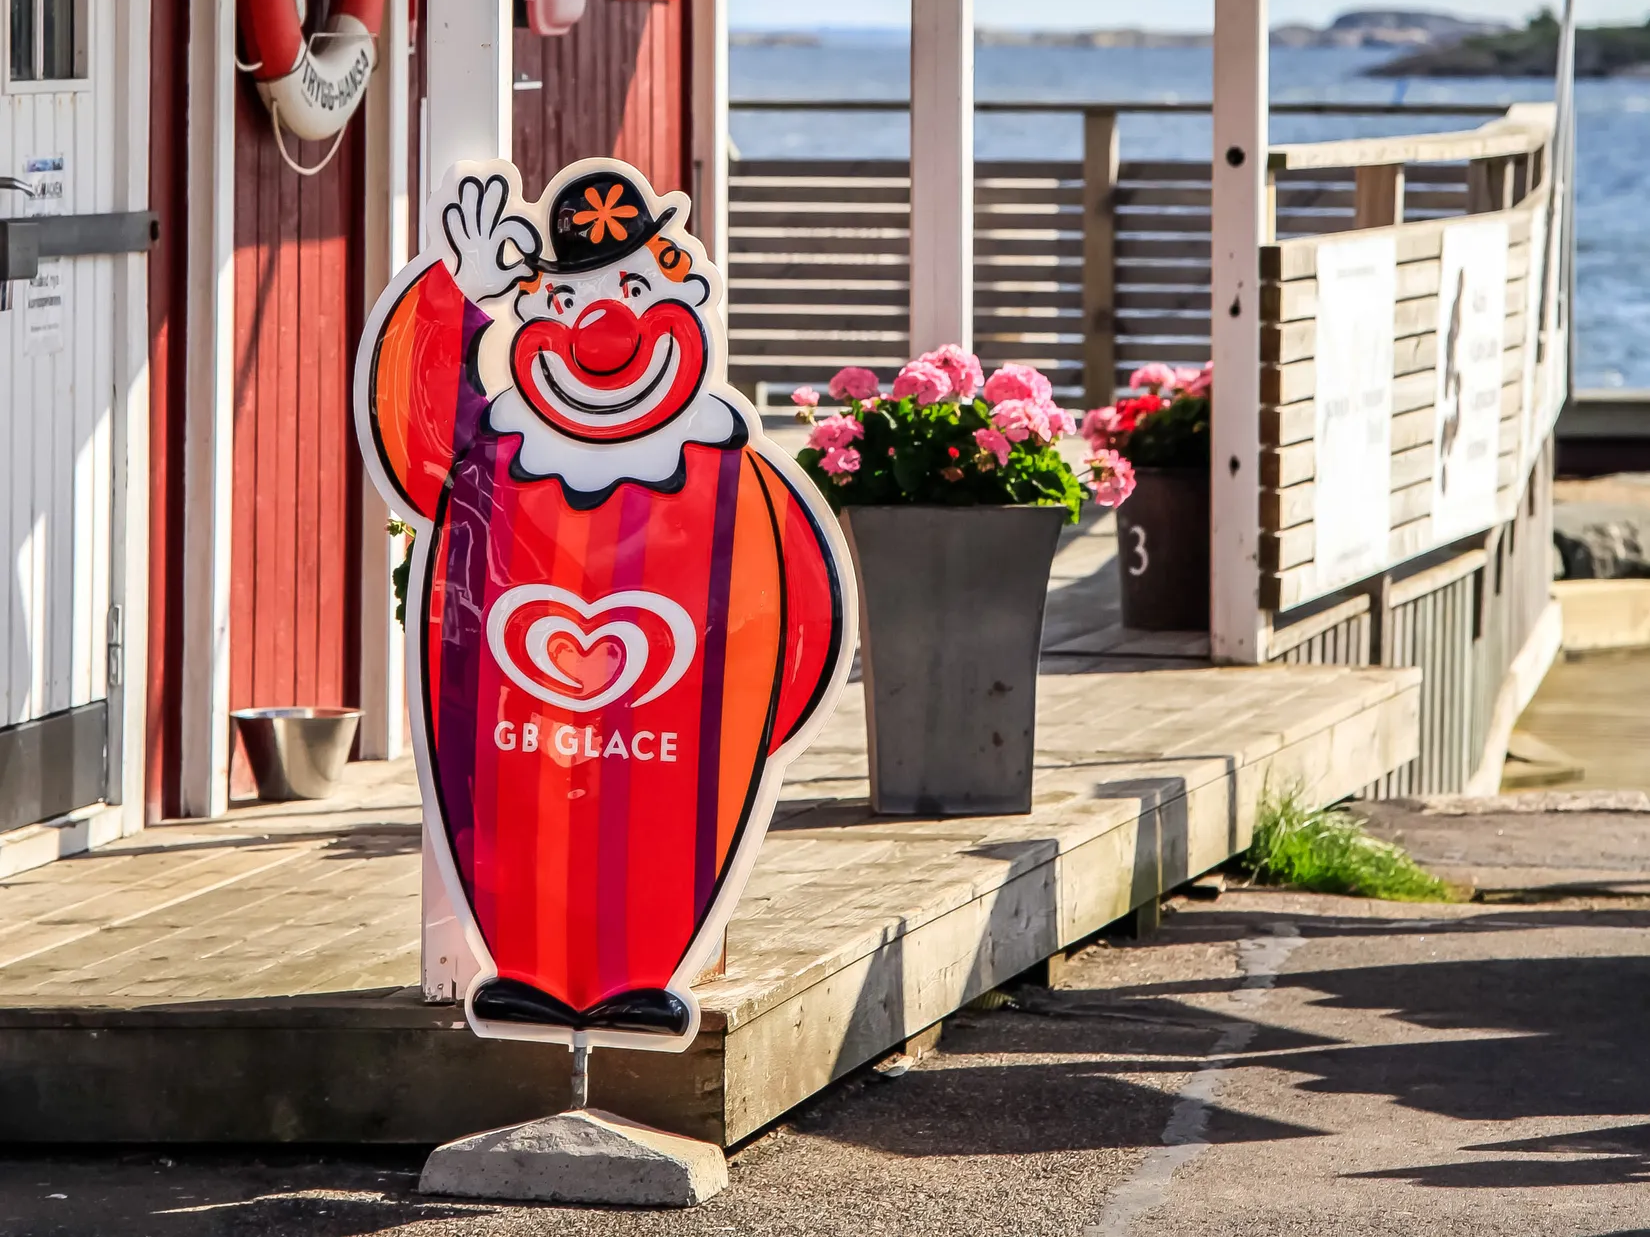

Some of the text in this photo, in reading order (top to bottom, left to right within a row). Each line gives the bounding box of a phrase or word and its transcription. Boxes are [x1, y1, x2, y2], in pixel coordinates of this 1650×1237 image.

[1129, 525, 1149, 576] 3
[494, 720, 678, 763] GB GLACE
